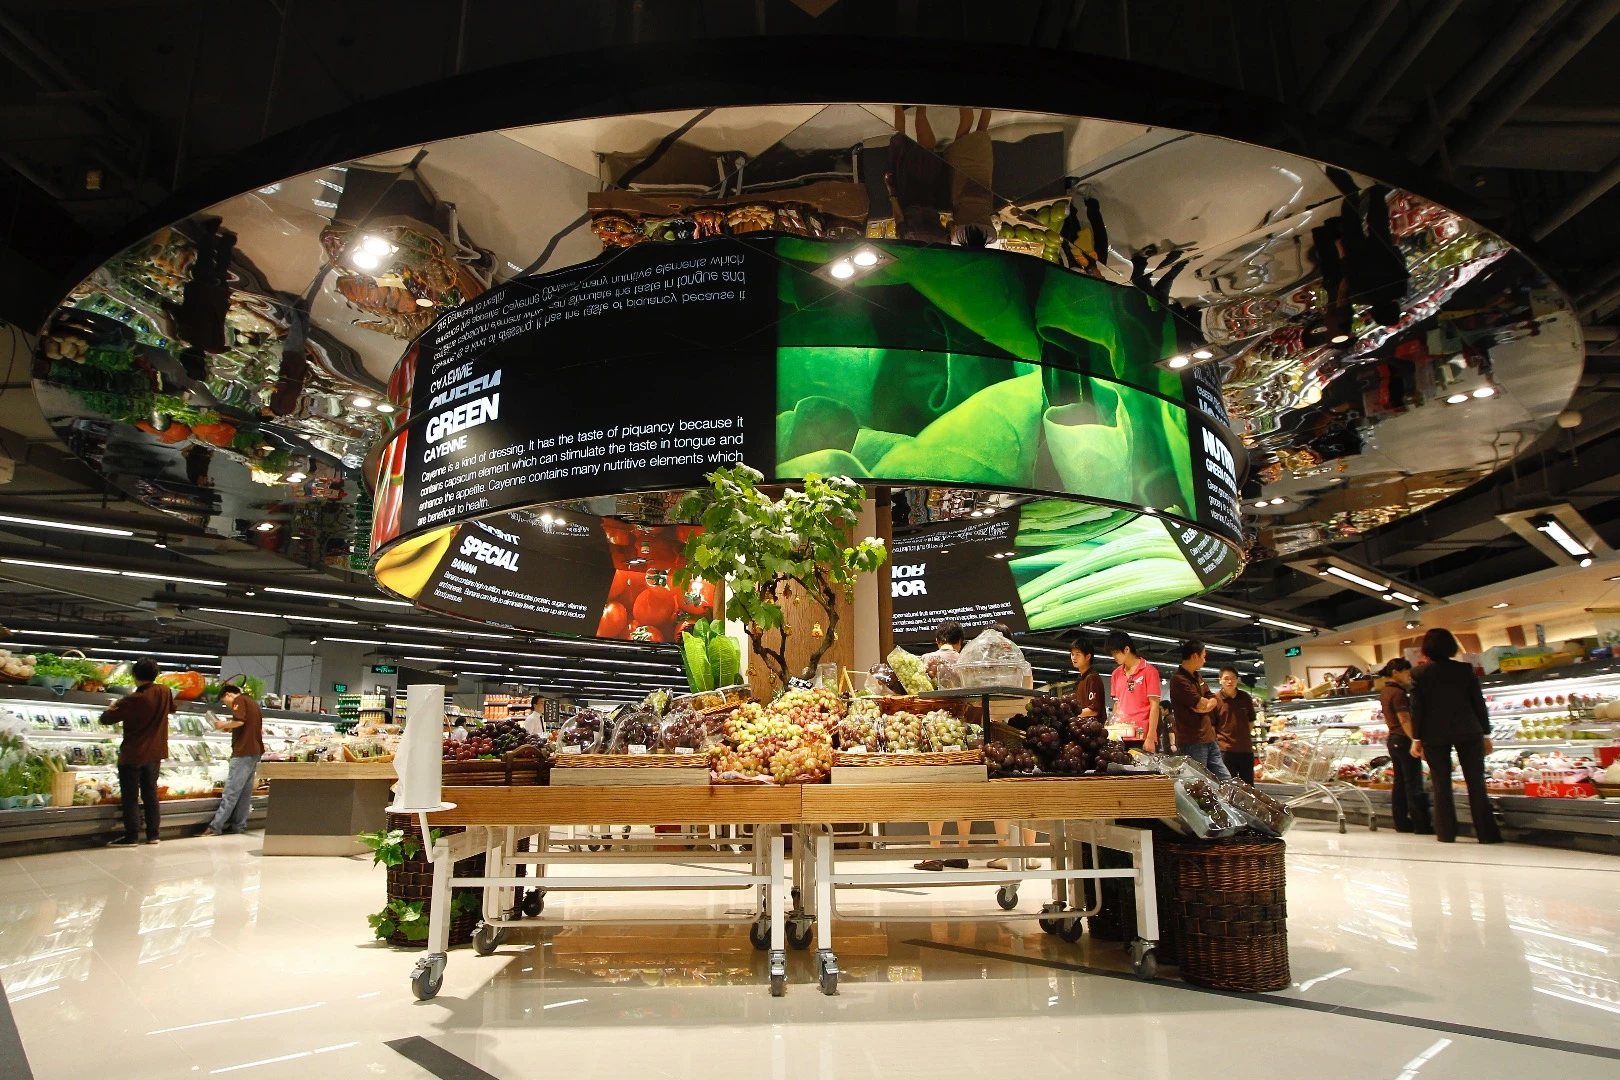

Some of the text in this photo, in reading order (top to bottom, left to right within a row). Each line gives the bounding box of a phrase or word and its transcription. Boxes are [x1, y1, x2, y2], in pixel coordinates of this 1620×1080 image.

[426, 393, 500, 444] GREEN
[420, 433, 743, 497] contains capsicum element which can stimulate the taste in tongue and
[421, 416, 743, 482] Cayenne is a kind of dressing. It has the taste of piquancy because it
[424, 435, 467, 464] CAYENNE
[418, 450, 743, 512] enhance the appetite. Cayenne contains many nutritive elements which
[417, 497, 490, 526] are beneficial to health.
[451, 558, 478, 575] BANANA
[459, 535, 520, 572] SPECIAL
